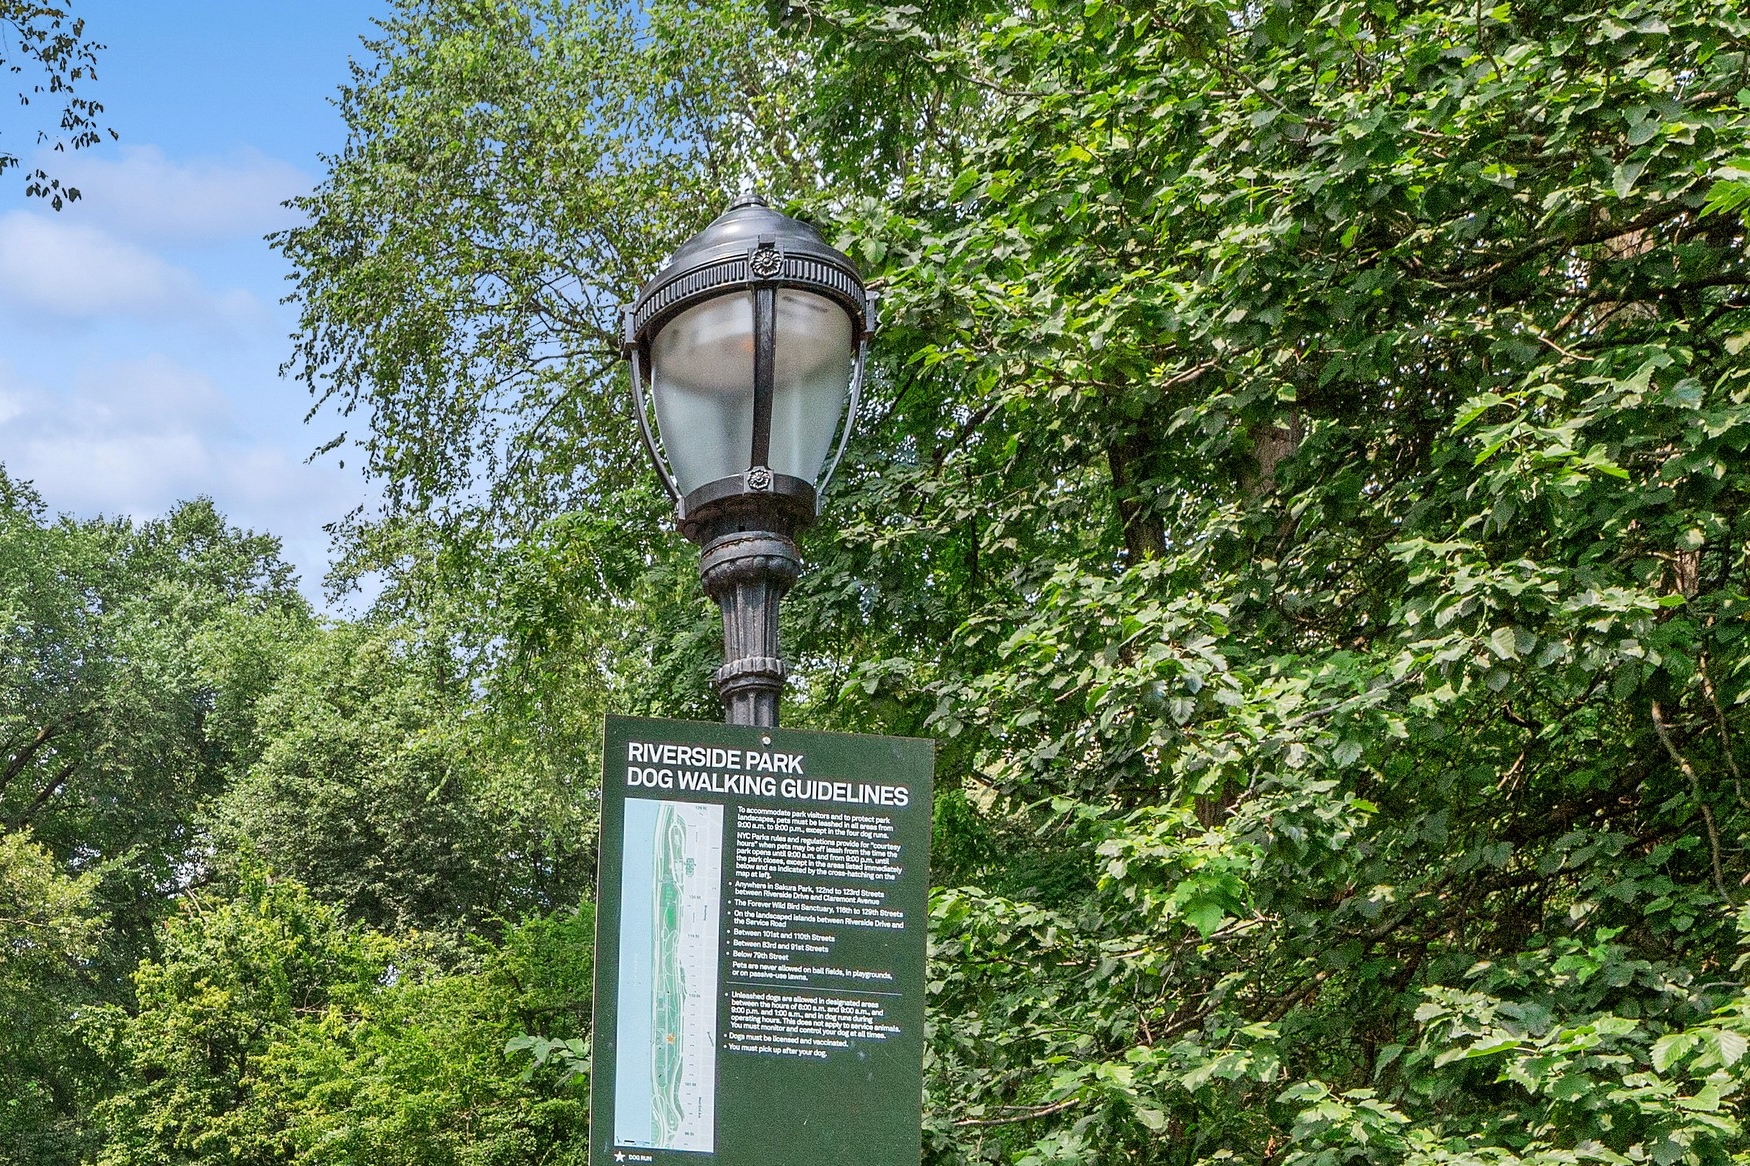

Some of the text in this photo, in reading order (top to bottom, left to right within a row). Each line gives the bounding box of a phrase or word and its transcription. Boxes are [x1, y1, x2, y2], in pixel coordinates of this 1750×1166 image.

[627, 741, 803, 774] RIVERSIDE PARK
[626, 766, 909, 806] DOG WALKING GUIDELINES
[746, 807, 790, 816] accommodate
[792, 810, 805, 819] park
[807, 811, 829, 819] visitors
[851, 815, 874, 824] protect
[875, 816, 890, 825] park
[805, 826, 826, 835] except
[860, 830, 871, 838] dog
[770, 834, 785, 842] rules
[800, 837, 834, 847] regulations
[836, 839, 858, 848] provide
[736, 847, 750, 855] park
[752, 849, 770, 857] opens
[734, 880, 766, 890] Anywhere
[774, 883, 796, 891] Sakura
[797, 885, 813, 893] Park,
[861, 889, 884, 897] Streets
[734, 888, 762, 896] between
[763, 890, 791, 898] Riverside
[823, 894, 855, 903] Claremont
[857, 897, 879, 905] Avenue
[772, 901, 785, 909] Wild
[801, 904, 834, 913] Sanctuary,
[880, 909, 903, 917] Streets
[746, 918, 768, 926] Service
[756, 911, 792, 921] landscaped
[793, 914, 815, 922] islands
[817, 916, 843, 924] between
[845, 918, 873, 926] Riverside
[733, 928, 761, 936] Between
[732, 939, 760, 947] Between
[805, 944, 828, 952] Streets
[732, 950, 752, 958] Below
[749, 970, 786, 980] passive-use
[788, 972, 808, 980] lawns.
[731, 991, 764, 1000] Unleashed
[766, 994, 780, 1002] dogs
[825, 998, 859, 1008] designated
[730, 1013, 760, 1023] operating
[825, 1020, 841, 1029] apply
[851, 1022, 873, 1030] service
[874, 1024, 900, 1032] animals.
[825, 1013, 836, 1021] dog
[852, 1015, 872, 1024] during
[728, 1032, 744, 1040] Dogs
[773, 1035, 798, 1043] licensed
[813, 1038, 848, 1046] vaccinated.
[758, 1045, 771, 1053] pick
[813, 1049, 827, 1057] dog.
